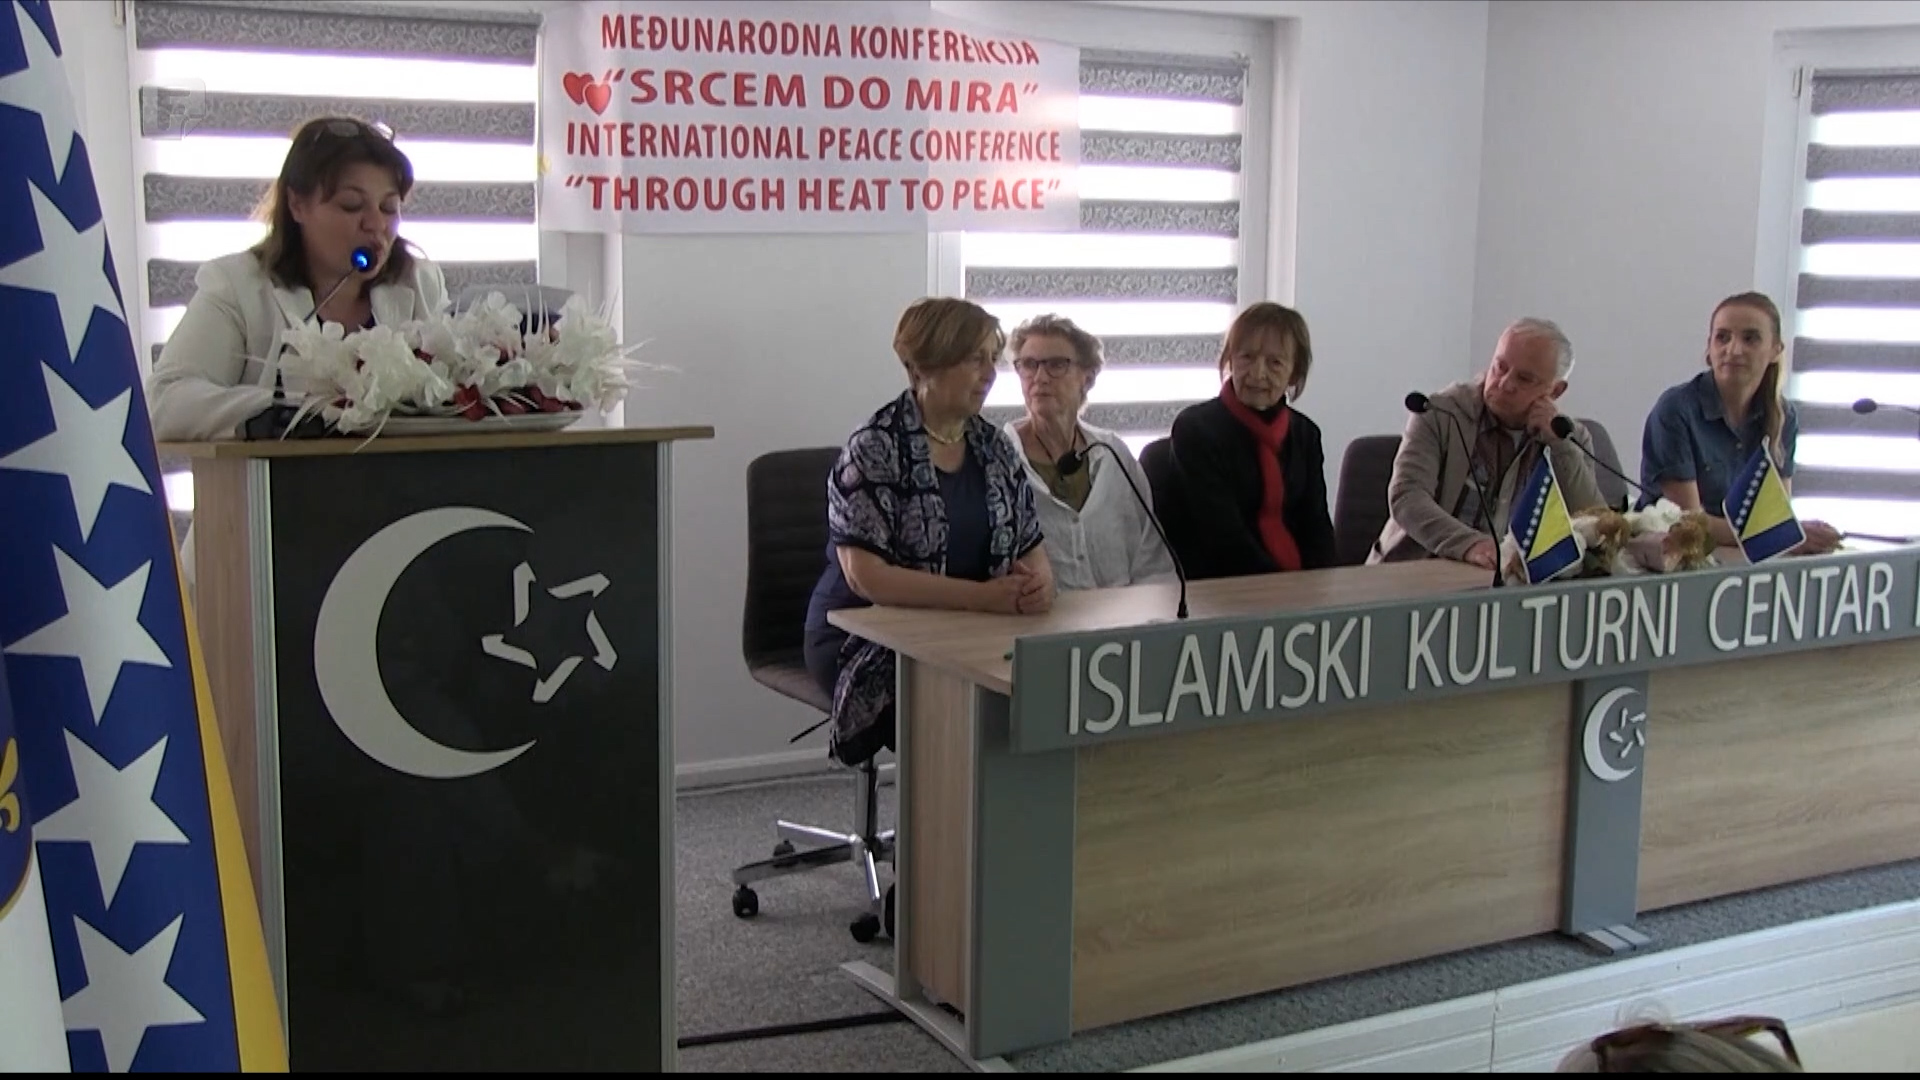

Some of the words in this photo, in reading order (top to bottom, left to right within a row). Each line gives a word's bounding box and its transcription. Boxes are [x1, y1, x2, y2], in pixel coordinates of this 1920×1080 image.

[602, 13, 842, 58] MEĐUNARODNA
[850, 25, 1040, 66] KONFERENCIJA
[604, 69, 806, 107] "SRCEM
[824, 75, 891, 110] DO
[905, 78, 1038, 114] MIRA"
[566, 122, 809, 160] INTERNATIONAL
[818, 126, 903, 162] PEACE
[909, 128, 1062, 162] CONFERENCE
[565, 174, 785, 212] "THROUGH
[799, 178, 892, 212] HEAT
[900, 180, 945, 212] TO
[952, 178, 1062, 212] PEACE"
[1068, 615, 1372, 736] ISLAMSKI
[1407, 582, 1679, 691] KULTURNI
[1708, 561, 1894, 652] CENTAR
